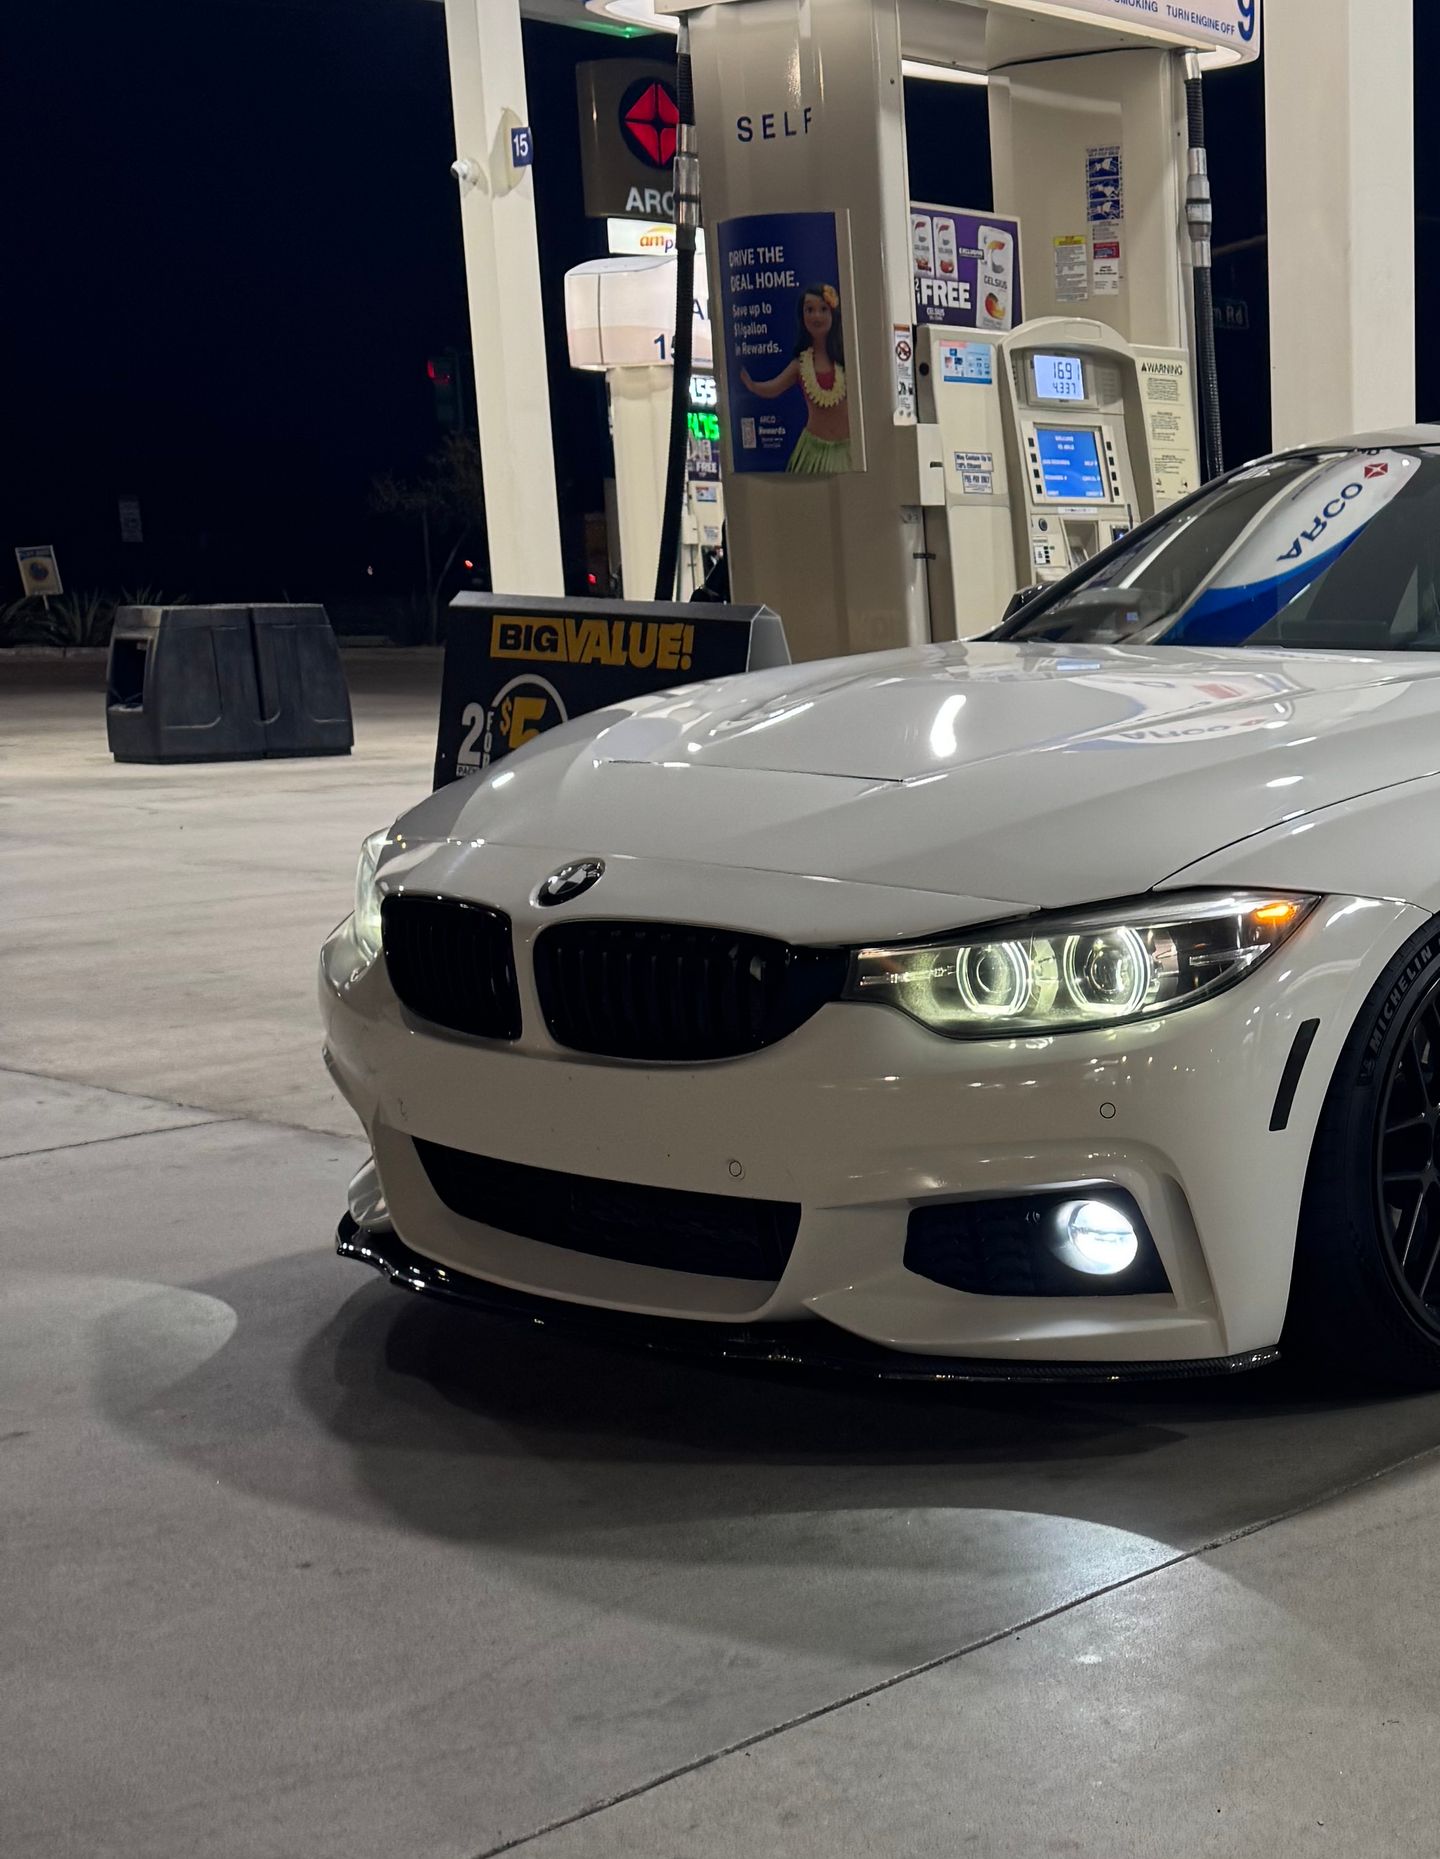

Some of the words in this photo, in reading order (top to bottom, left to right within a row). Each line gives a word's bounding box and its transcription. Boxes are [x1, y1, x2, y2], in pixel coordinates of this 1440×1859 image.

[1114, 0, 1158, 12] OKING
[1166, 5, 1190, 22] TURN
[1191, 12, 1220, 31] ENGINE
[1221, 22, 1235, 35] OFF
[1237, 0, 1255, 41] 9
[737, 107, 812, 142] SELF
[513, 133, 529, 157] 15
[625, 186, 675, 216] ARC
[640, 234, 674, 253] amp
[729, 248, 755, 267] DRIVE
[757, 246, 785, 264] THE
[731, 272, 754, 292] DEAL
[756, 270, 800, 289] HOME.
[921, 278, 971, 309] FREE
[749, 304, 760, 318] up
[762, 302, 772, 314] to
[654, 333, 676, 360] 1
[742, 340, 783, 355] Rewards.
[1147, 363, 1183, 376] WARNING
[696, 461, 717, 474] FREE
[500, 624, 558, 652] BIG
[565, 618, 695, 671] VALUE!
[458, 702, 484, 765] 2
[483, 711, 494, 768] FOR
[500, 696, 548, 749] $5
[1368, 944, 1433, 1054] MICHELIN
